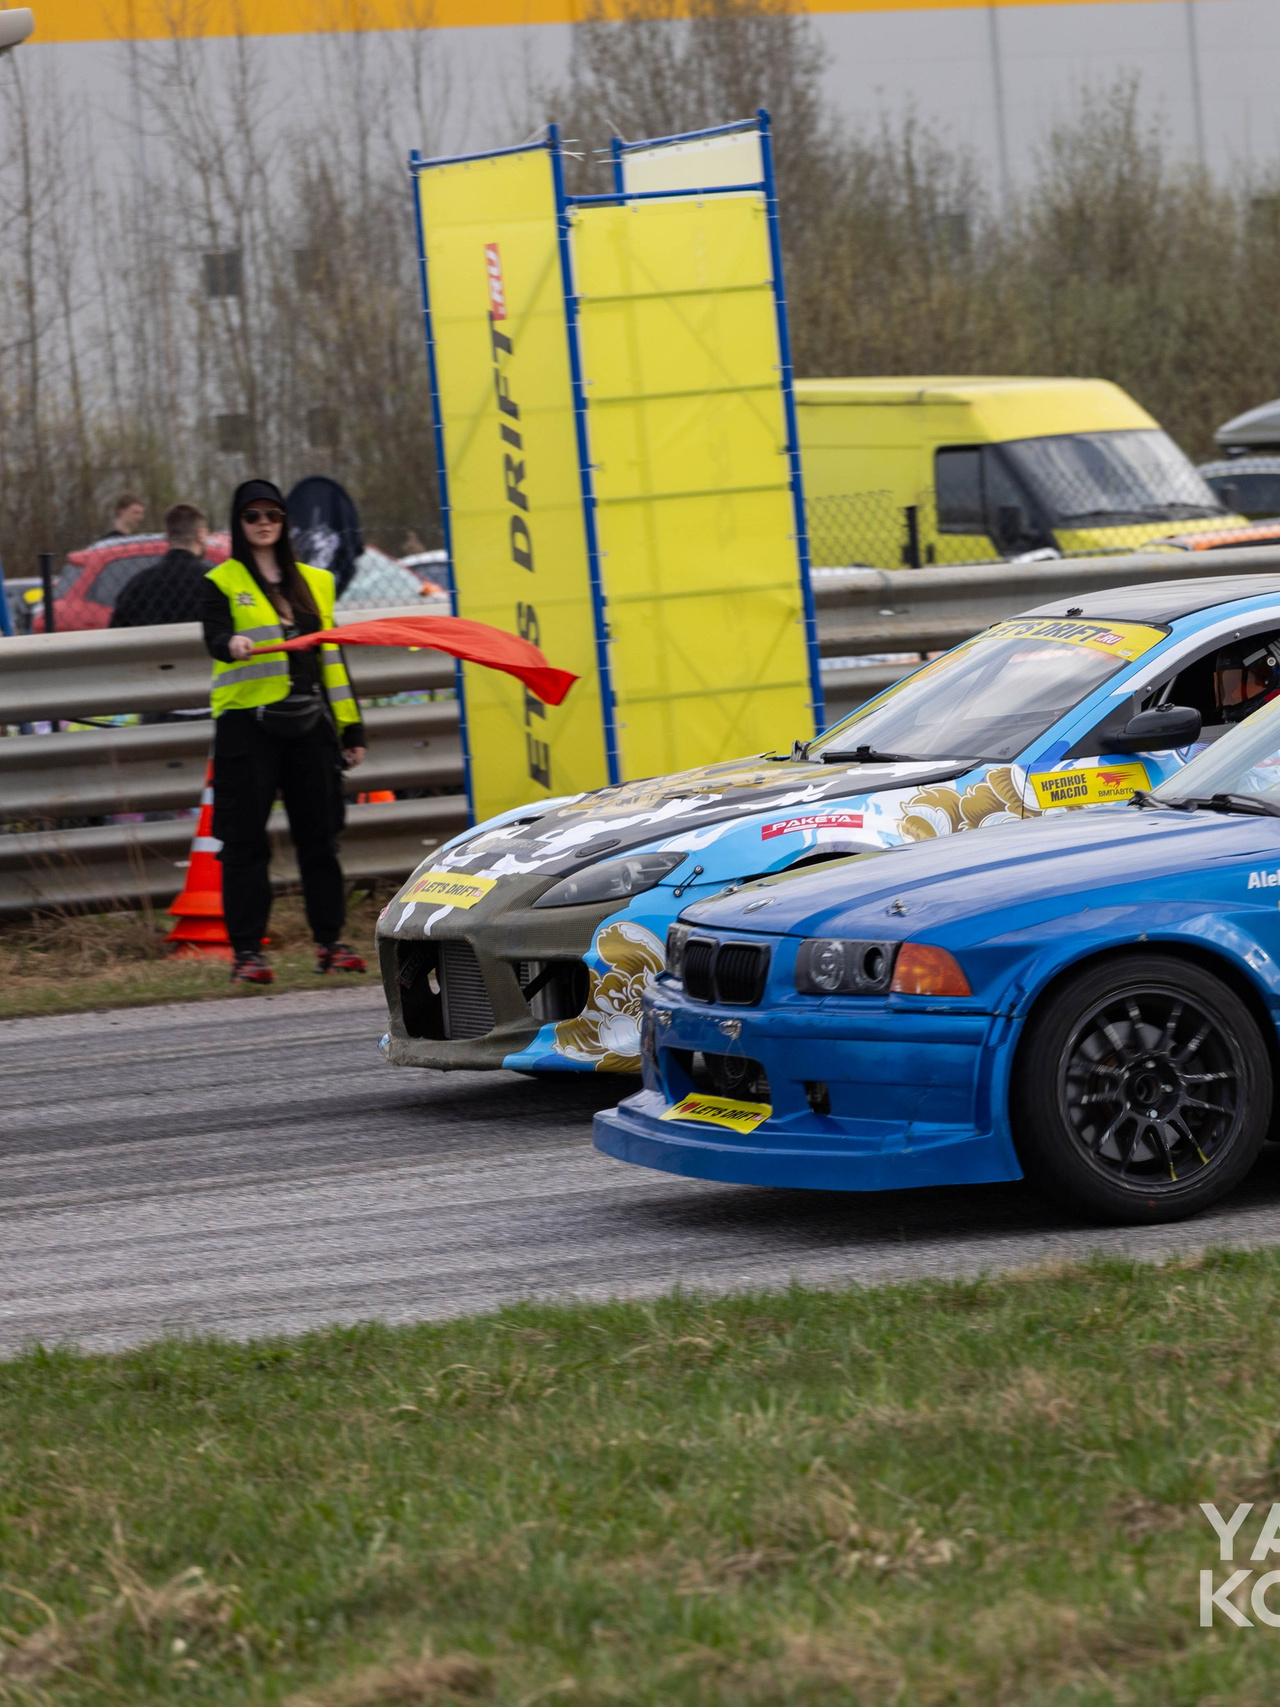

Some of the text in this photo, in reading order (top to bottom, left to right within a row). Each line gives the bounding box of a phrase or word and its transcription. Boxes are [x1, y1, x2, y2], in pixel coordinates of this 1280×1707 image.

[1041, 774, 1087, 791] КРЕПКОЕ
[1050, 785, 1088, 802] МАСЛО
[1098, 787, 1135, 798] ВМПАВТО
[421, 881, 450, 894] LET'S
[689, 1104, 729, 1117] LET'S
